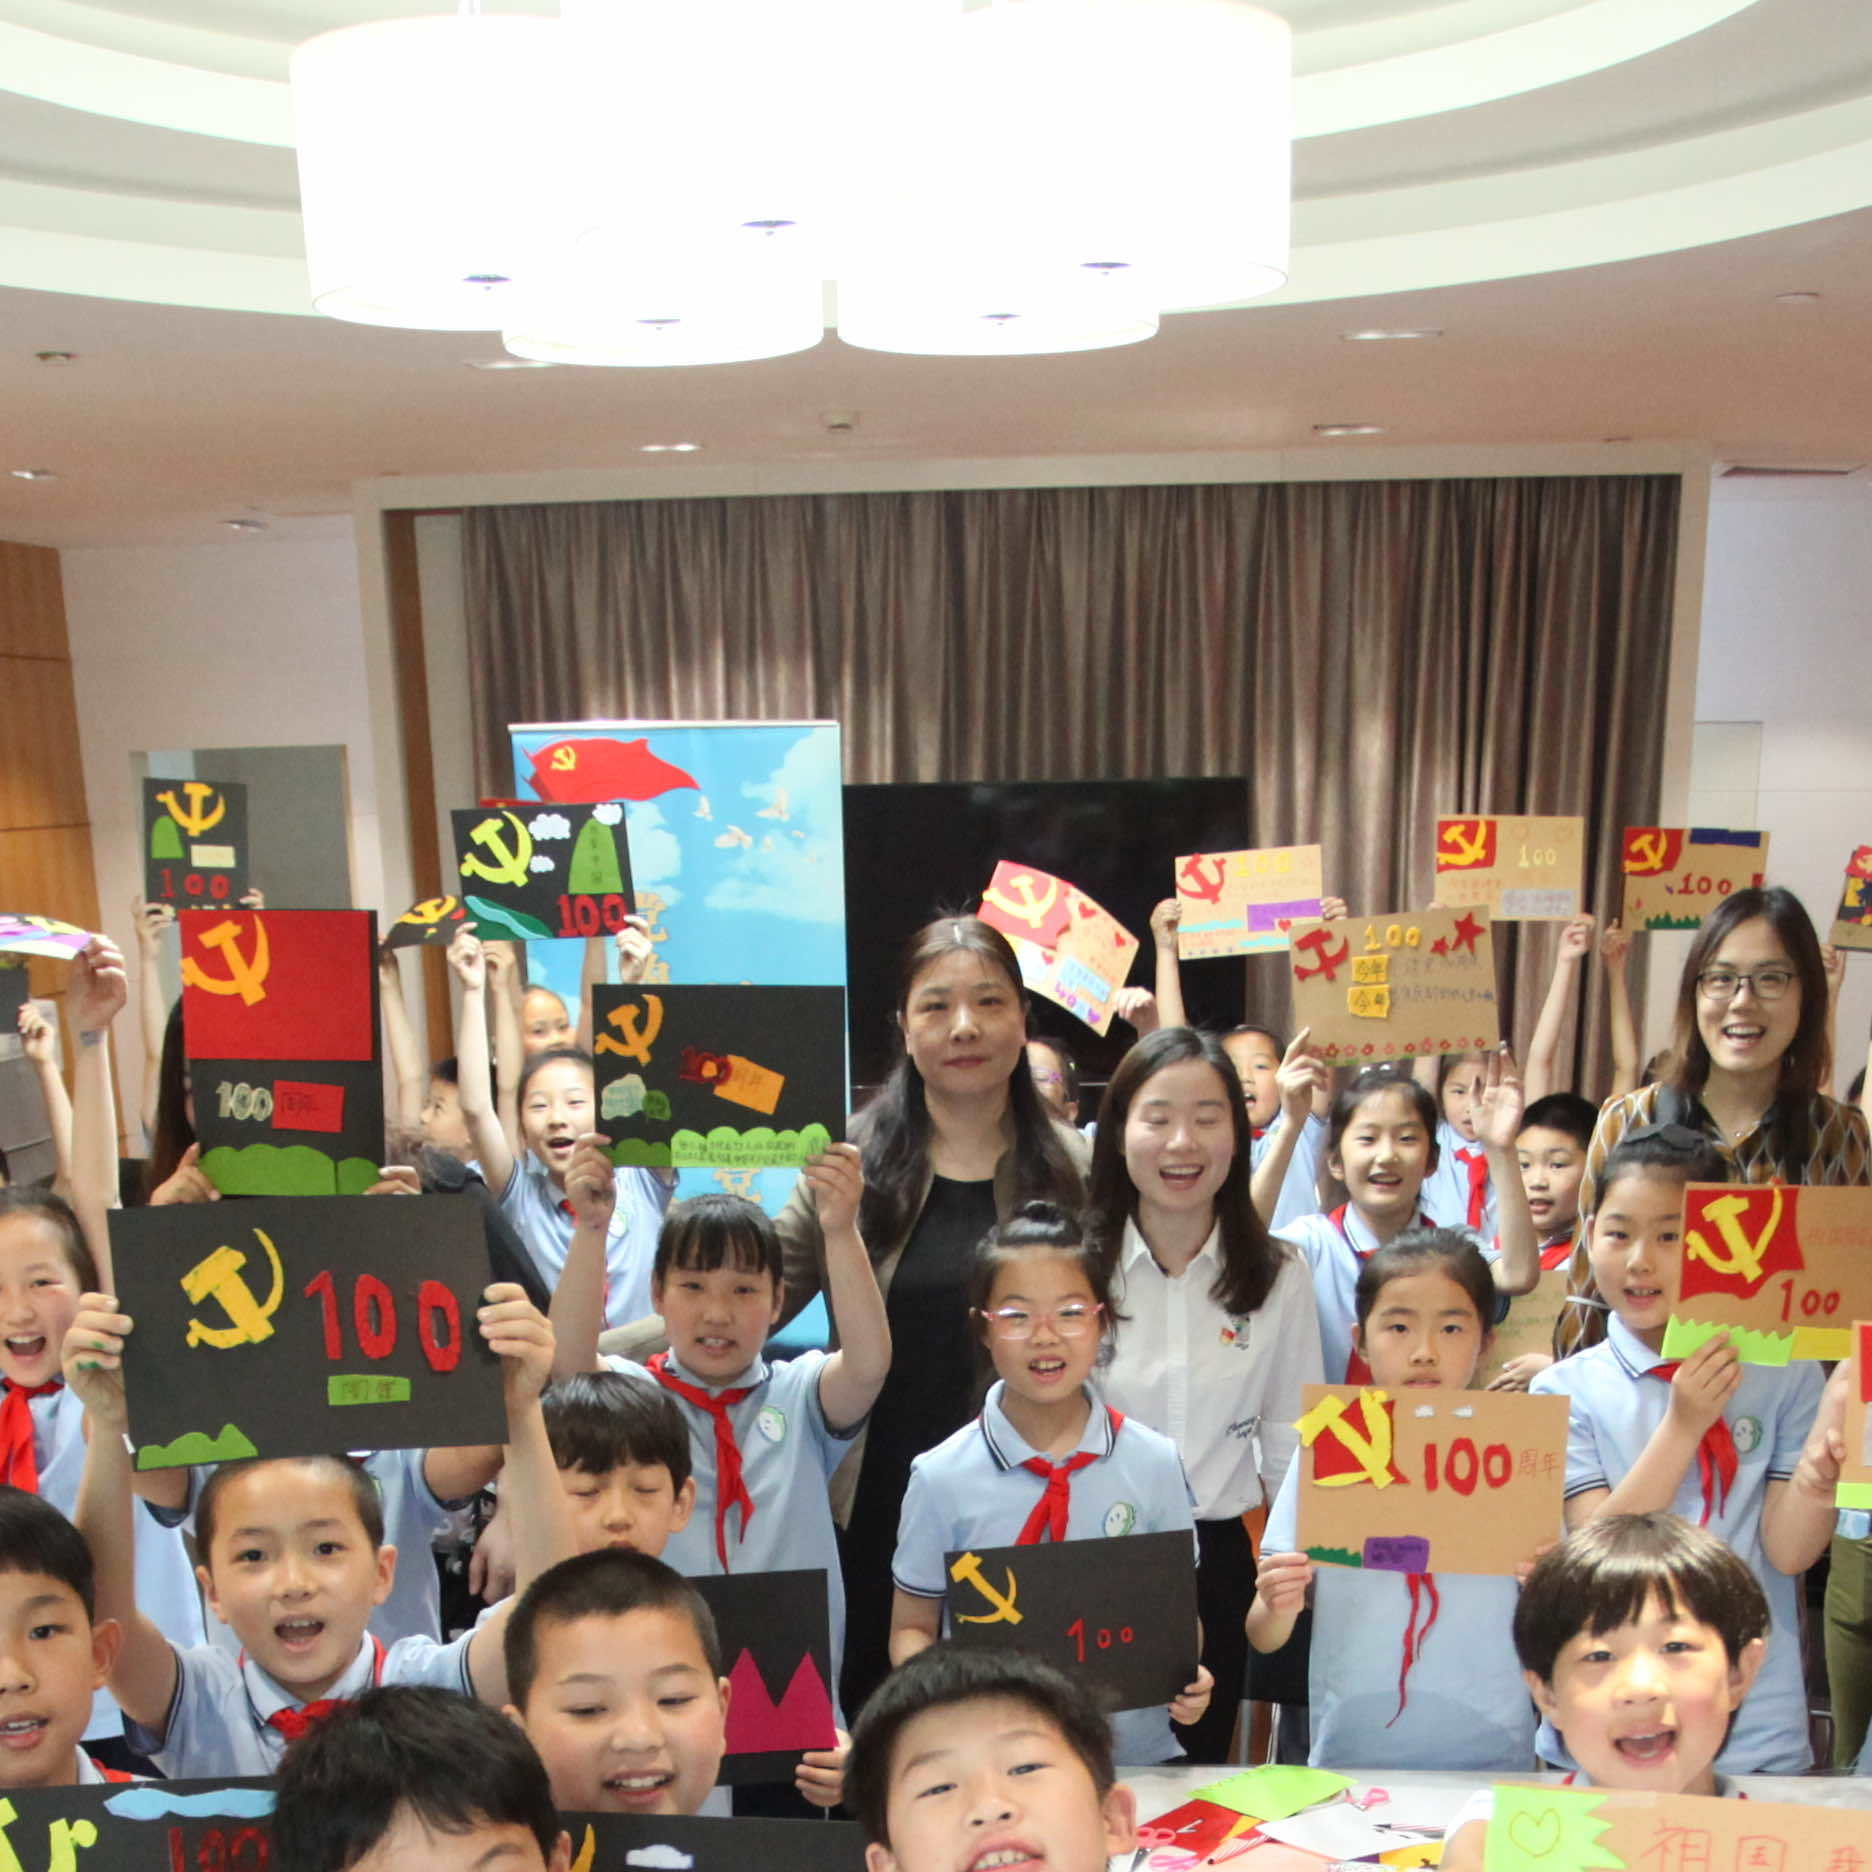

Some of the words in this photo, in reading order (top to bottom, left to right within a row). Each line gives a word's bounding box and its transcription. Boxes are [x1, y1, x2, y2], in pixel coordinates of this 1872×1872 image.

[1518, 846, 1557, 867] 100
[159, 868, 232, 899] 100
[1678, 873, 1733, 896] 100
[558, 894, 628, 937] 100
[1364, 923, 1422, 951] 100
[216, 1081, 273, 1121] 100
[303, 1269, 462, 1372] 100
[1780, 1278, 1841, 1322] 100
[1424, 1437, 1512, 1496] 100
[1065, 1617, 1135, 1663] 100
